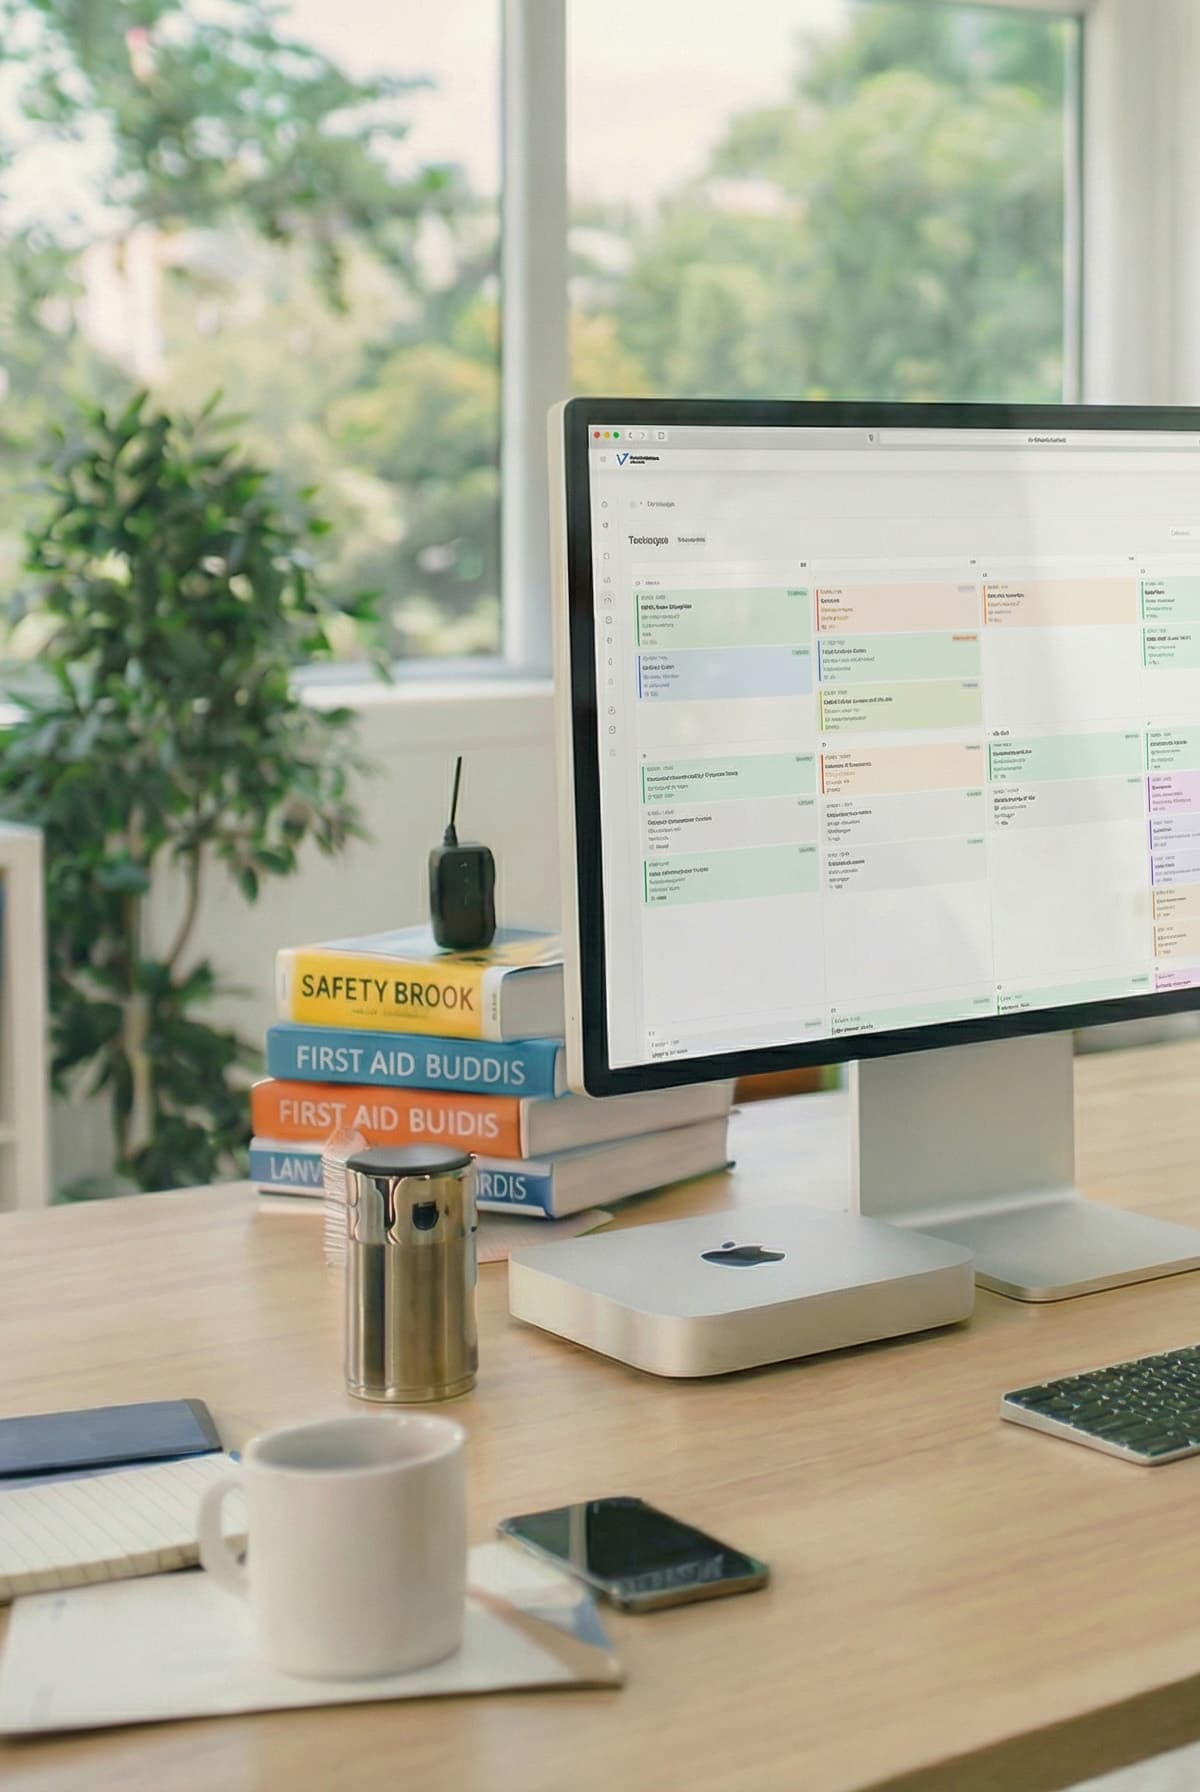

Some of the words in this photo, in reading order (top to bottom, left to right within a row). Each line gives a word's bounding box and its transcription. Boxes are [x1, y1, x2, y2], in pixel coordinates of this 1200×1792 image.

[302, 974, 388, 1004] SAFETY
[394, 981, 475, 1012] BROOK
[296, 1045, 364, 1073] FIRST
[370, 1051, 415, 1077] AID
[426, 1053, 526, 1085] BUDDIS
[279, 1099, 346, 1130] FIRST
[353, 1104, 398, 1131] AID
[475, 1172, 527, 1200] RDIS
